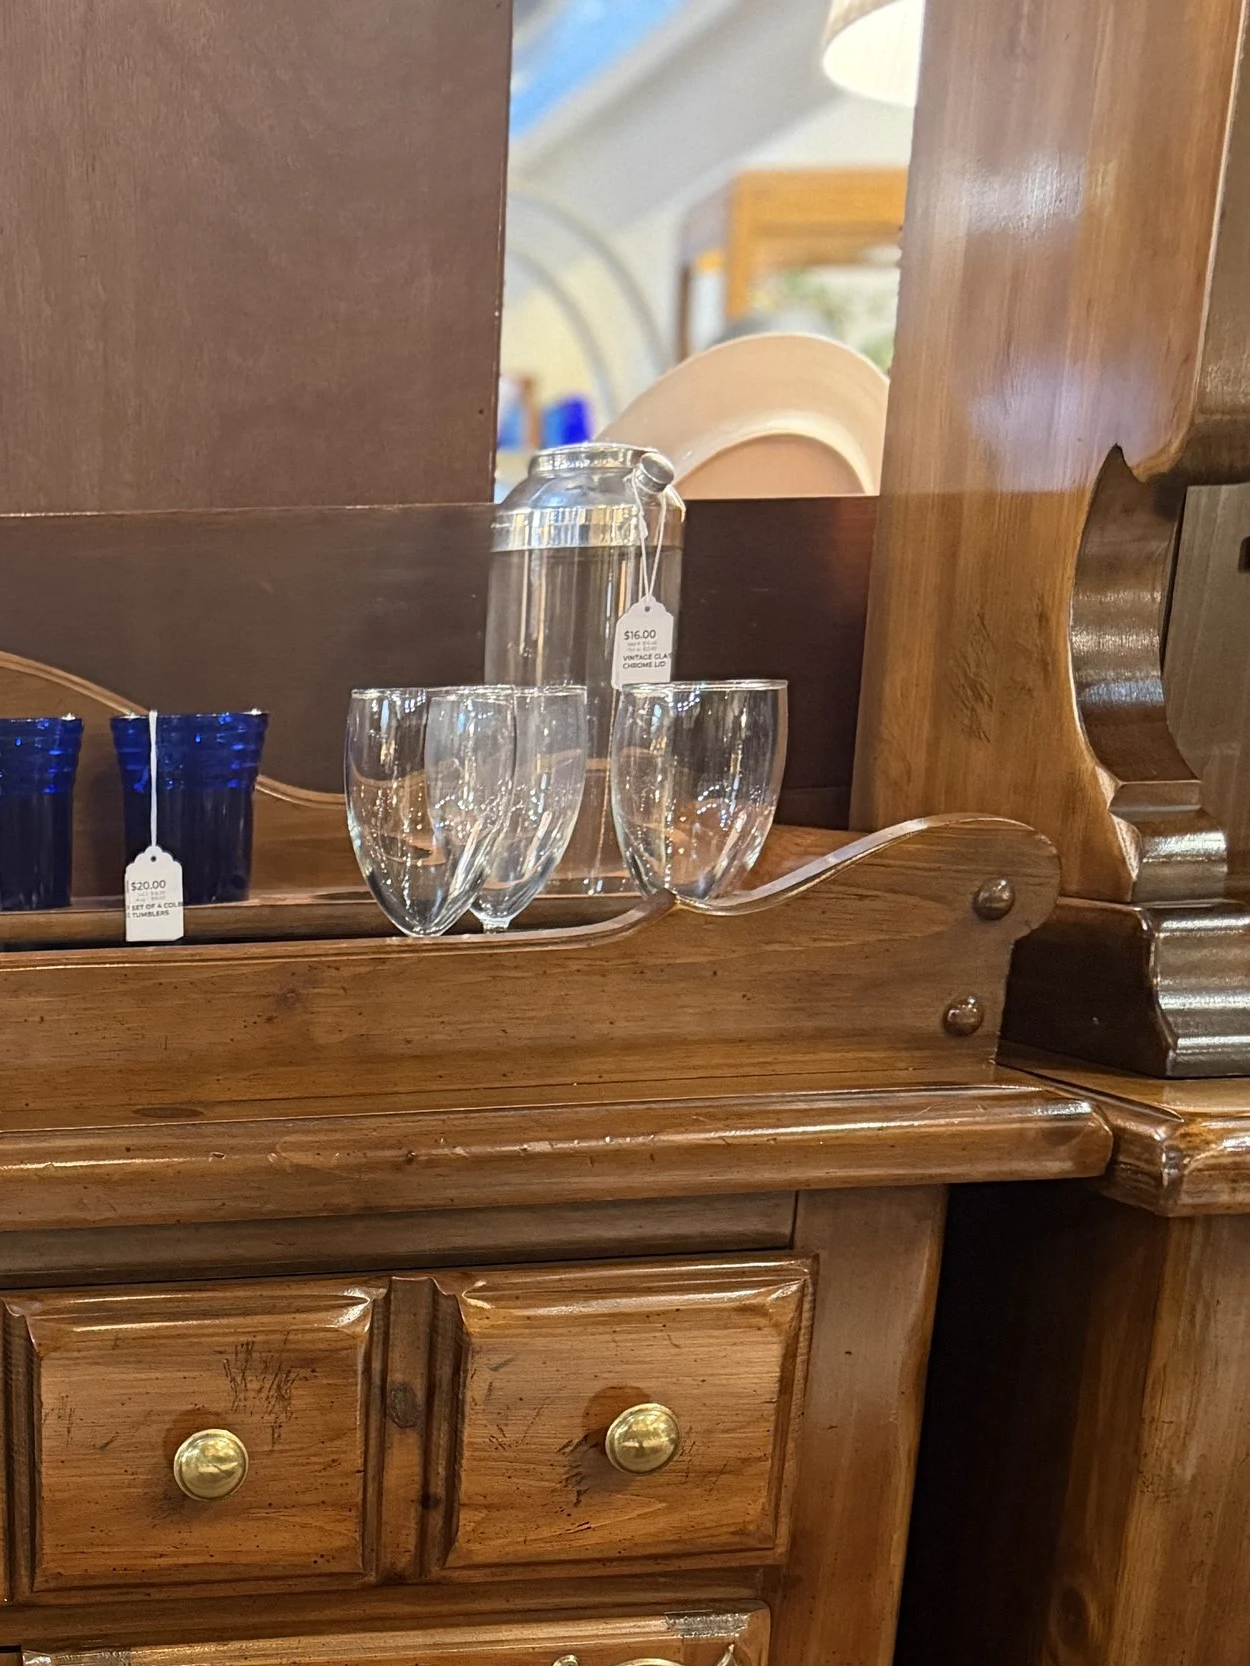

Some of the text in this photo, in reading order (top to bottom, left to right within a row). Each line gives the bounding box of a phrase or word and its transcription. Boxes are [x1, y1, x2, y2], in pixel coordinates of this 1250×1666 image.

[624, 629, 656, 640] $16.00
[623, 653, 653, 661] VINTAGE
[623, 661, 653, 669] CHROME
[131, 880, 166, 891] $20.00
[132, 910, 169, 918] TUMBLERS
